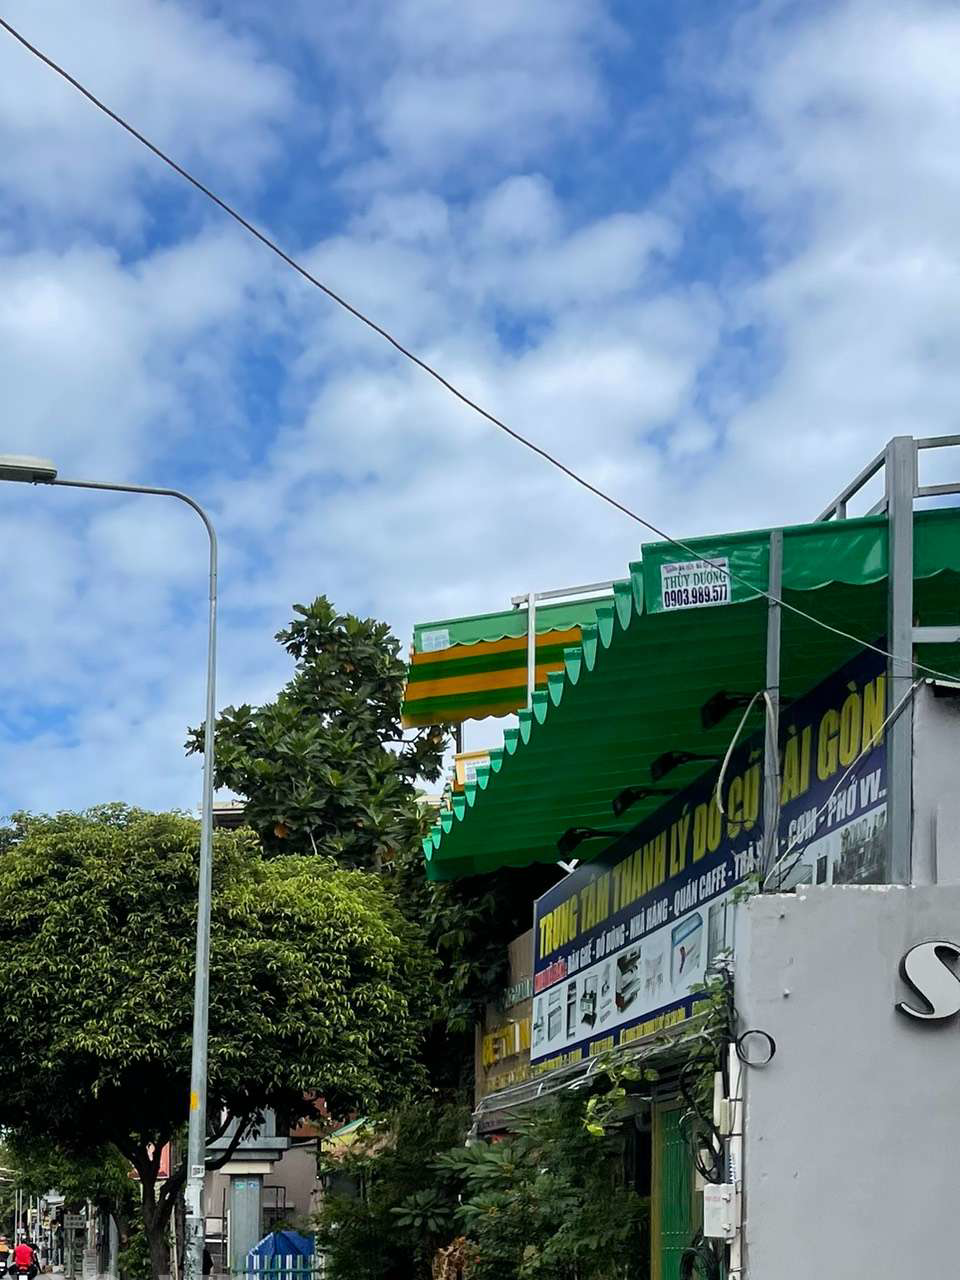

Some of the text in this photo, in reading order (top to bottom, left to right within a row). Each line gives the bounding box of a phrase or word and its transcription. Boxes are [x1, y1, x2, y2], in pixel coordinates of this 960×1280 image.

[664, 584, 728, 607] 0903.989.577
[540, 894, 577, 959] TRUNG
[613, 831, 667, 914] THANH
[670, 803, 690, 878] LÝ
[778, 724, 812, 806] ÀI
[817, 672, 887, 781] GÒN
[674, 879, 697, 916] QUÁN
[699, 863, 727, 900] CAFFE
